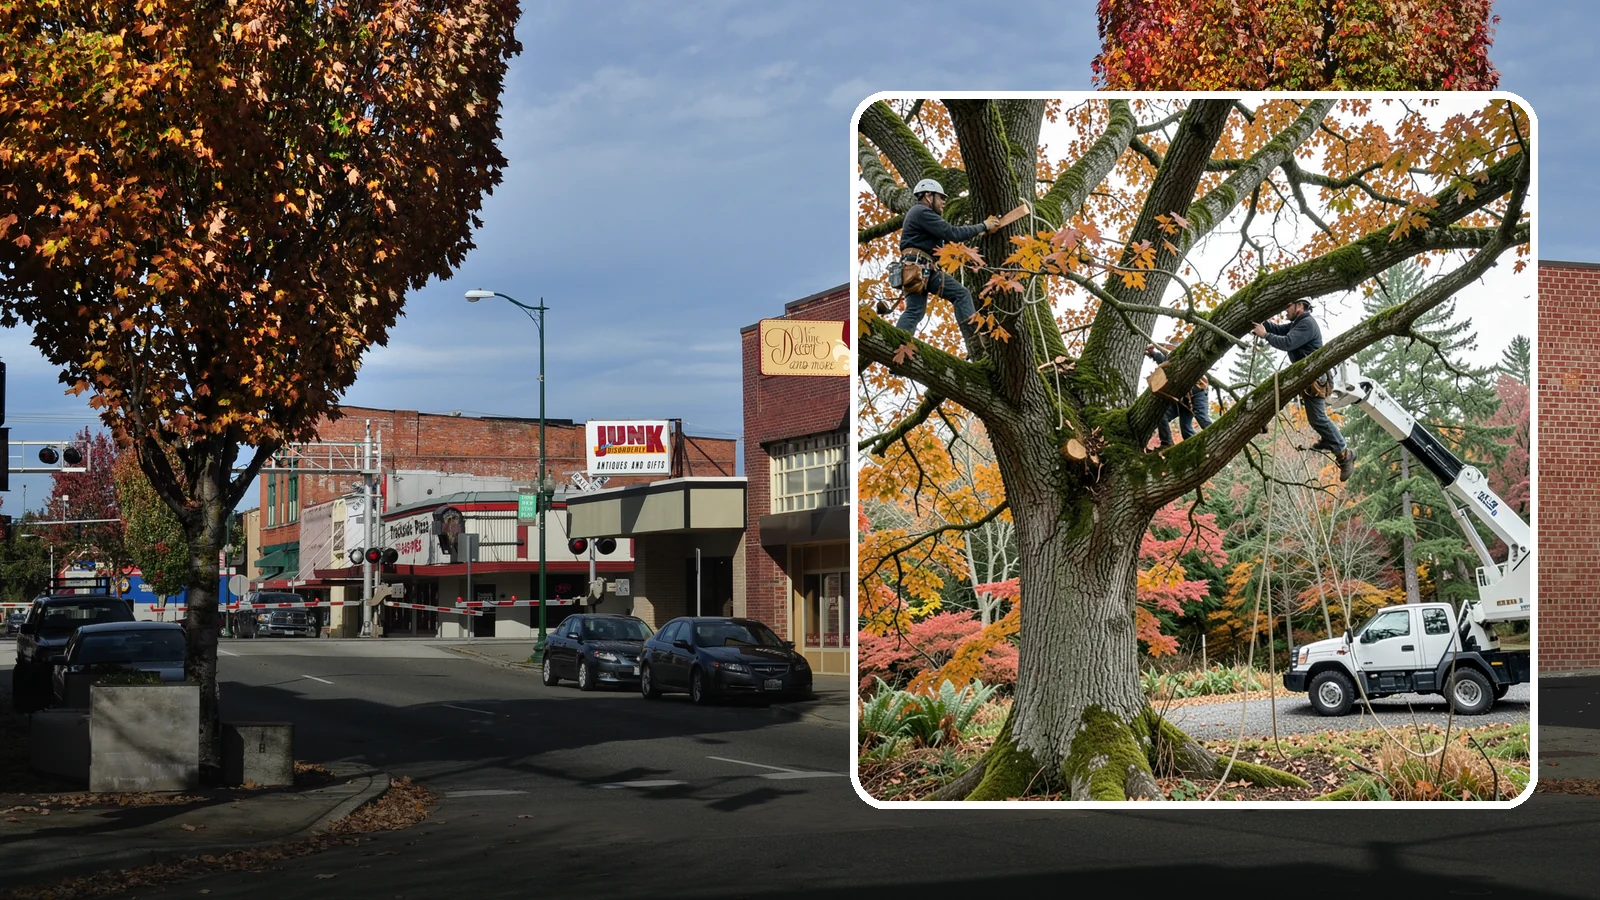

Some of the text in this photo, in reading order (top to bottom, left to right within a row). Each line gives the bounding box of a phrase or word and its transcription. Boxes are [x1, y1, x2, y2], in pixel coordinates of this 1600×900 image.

[595, 425, 665, 457] JUNK
[607, 446, 646, 454] DISORDERLY
[597, 460, 665, 470] ANTIQUES AND GIFTS
[573, 473, 589, 492] RAIL
[590, 476, 608, 491] SING
[352, 498, 364, 511] CRO
[390, 519, 429, 539] Trackside Pizza
